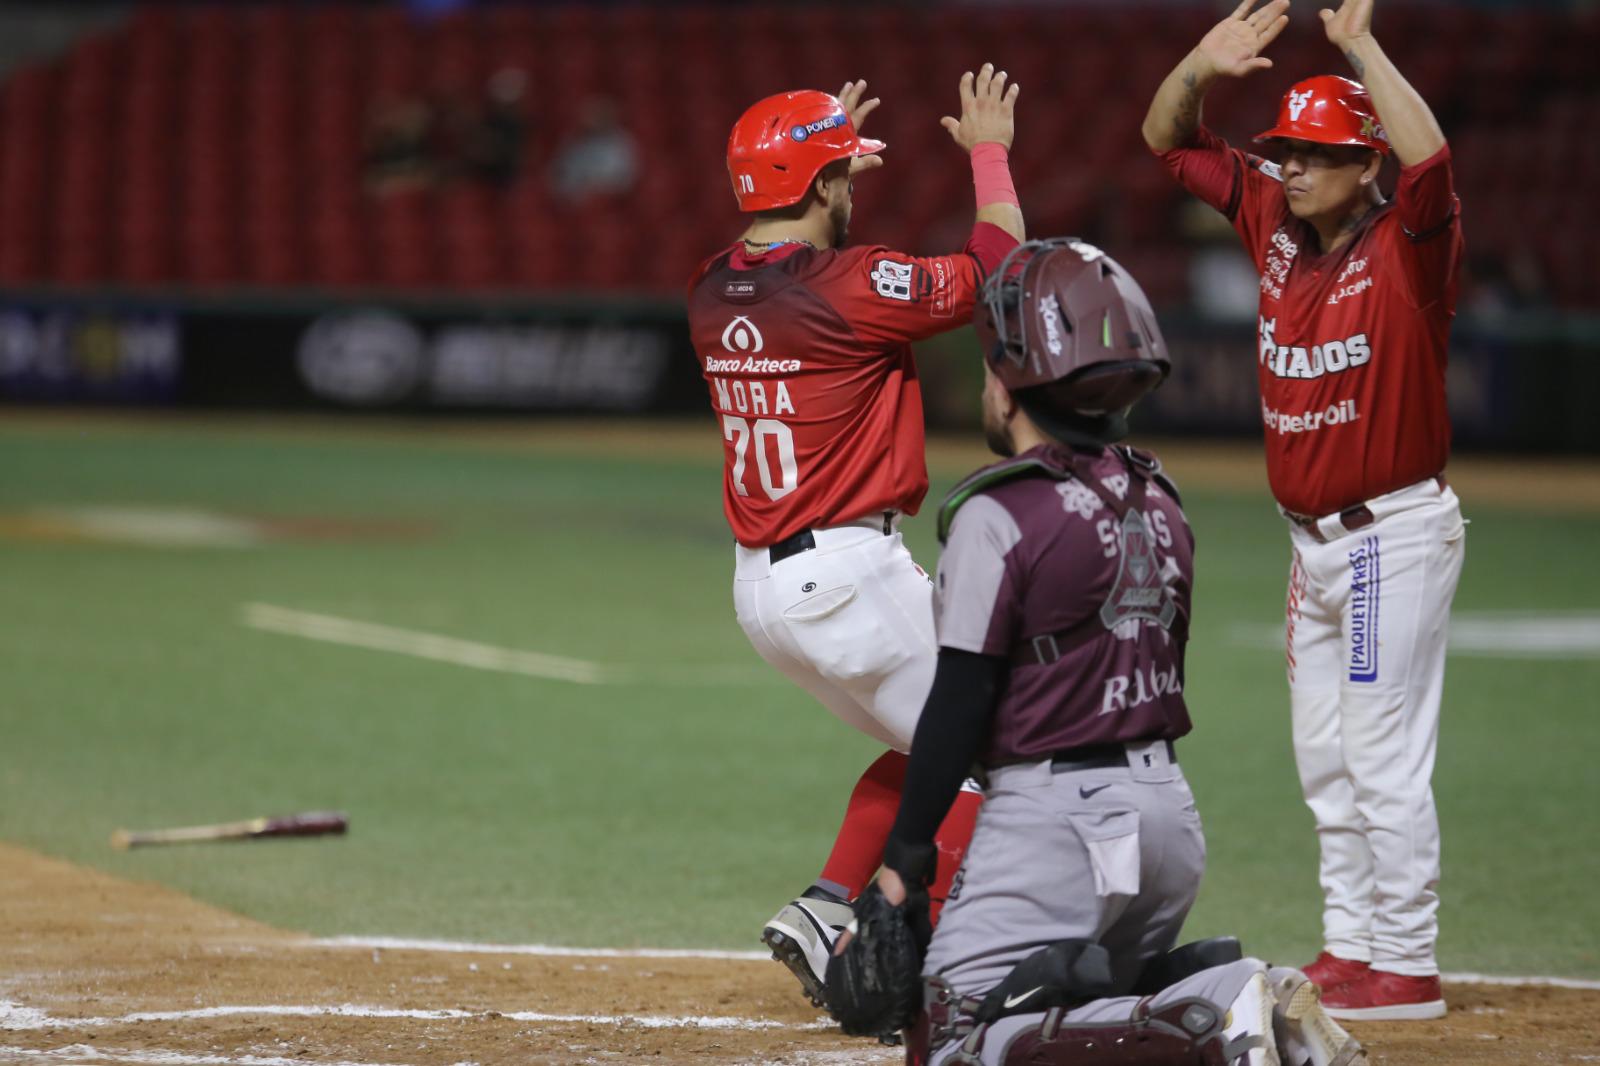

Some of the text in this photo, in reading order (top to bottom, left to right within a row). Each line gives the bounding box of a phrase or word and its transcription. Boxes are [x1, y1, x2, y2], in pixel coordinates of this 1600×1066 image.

[706, 355, 801, 373] Banco Azteca
[714, 377, 796, 415] MORA
[1262, 395, 1356, 435] edpetroil
[723, 414, 797, 501] 70
